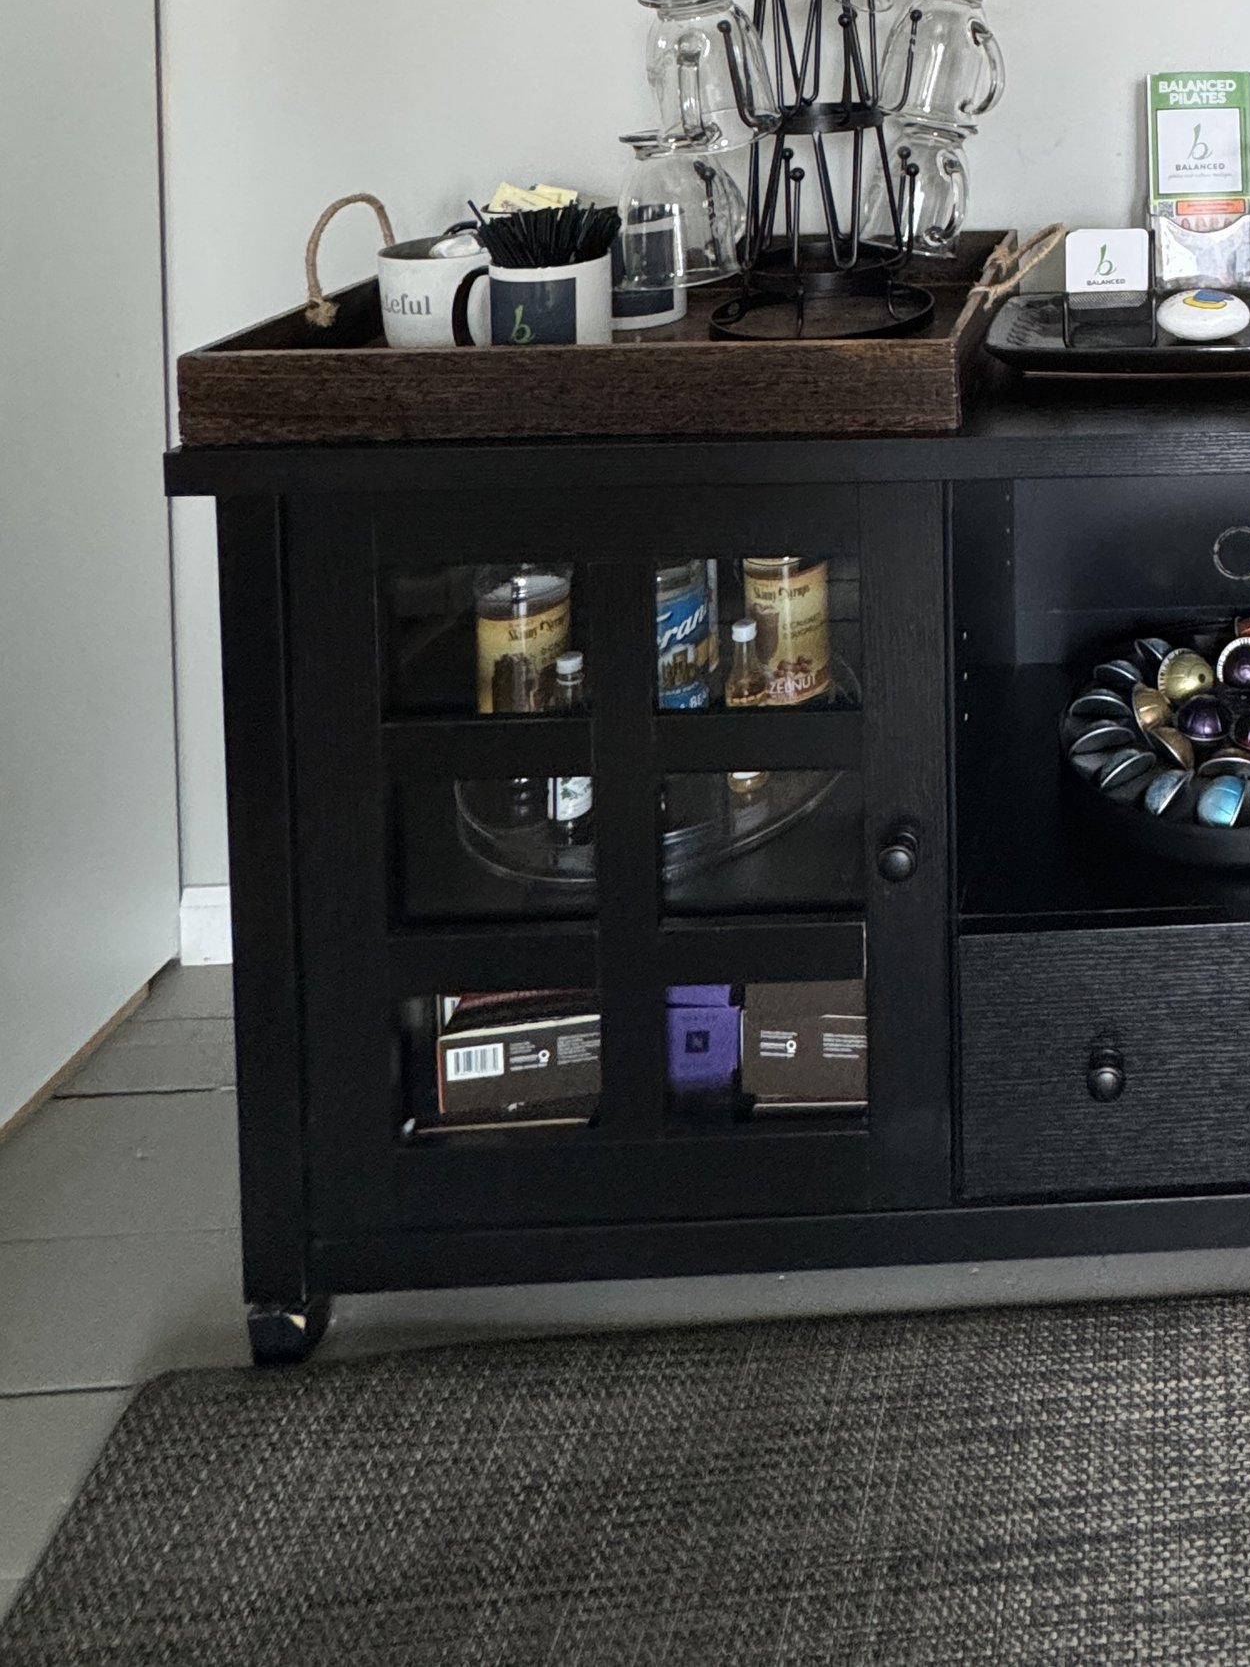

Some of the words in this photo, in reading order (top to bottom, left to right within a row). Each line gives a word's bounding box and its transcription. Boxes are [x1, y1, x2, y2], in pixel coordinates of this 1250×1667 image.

[1158, 79, 1237, 93] BALANCED
[1169, 92, 1227, 105] PILATES
[1175, 163, 1225, 172] BALANCED
[1086, 278, 1126, 286] BALANCED
[383, 293, 432, 315] teful
